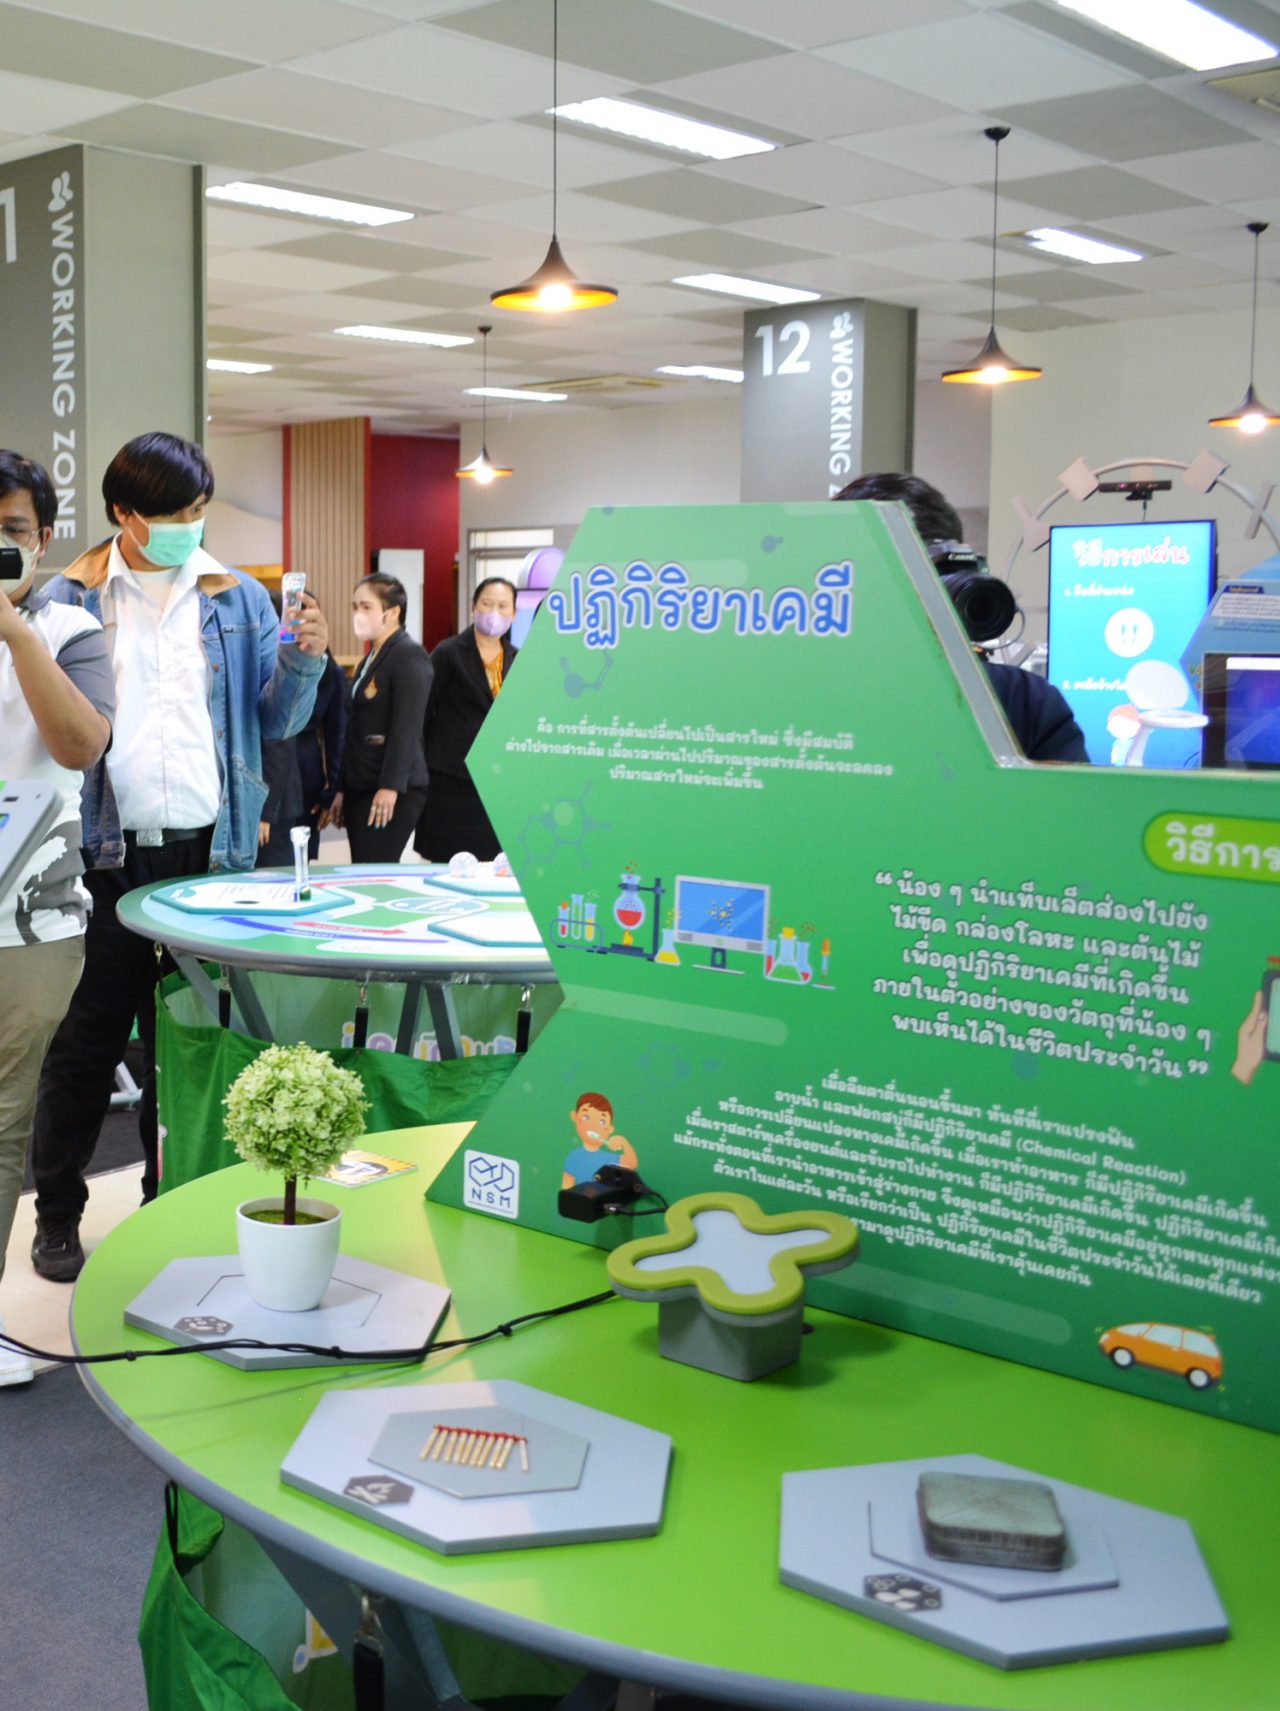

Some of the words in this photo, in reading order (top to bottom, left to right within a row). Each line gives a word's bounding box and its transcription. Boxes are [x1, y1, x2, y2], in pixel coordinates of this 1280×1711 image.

[51, 211, 75, 417] WORKING
[755, 320, 811, 376] 12
[829, 339, 854, 476] WORKING
[52, 430, 76, 539] ZONE
[1072, 535, 1190, 567] วิธีการเล่น
[549, 560, 853, 648] ปฏิกิริยาเคมี
[890, 904, 947, 933] ไม้ขีด
[955, 915, 1074, 951] กล่องโลหะ
[1083, 933, 1201, 968] และต้นไม้
[970, 878, 1208, 932] นำแท็บเล็ตส่องไปยัง
[903, 934, 1190, 1005] เพื่อดูปฏิกิริยาเคมีที่เกิดขึ้น
[873, 976, 1187, 1042] ภายในตัวอย่างของวัตถุที่น้อง
[1016, 1137, 1097, 1166] (Chemical
[1102, 1155, 1187, 1186] Reaction)
[471, 1187, 511, 1209] NSM
[1154, 1214, 1280, 1259] ปฏิกิริยาเคมีเกิ
